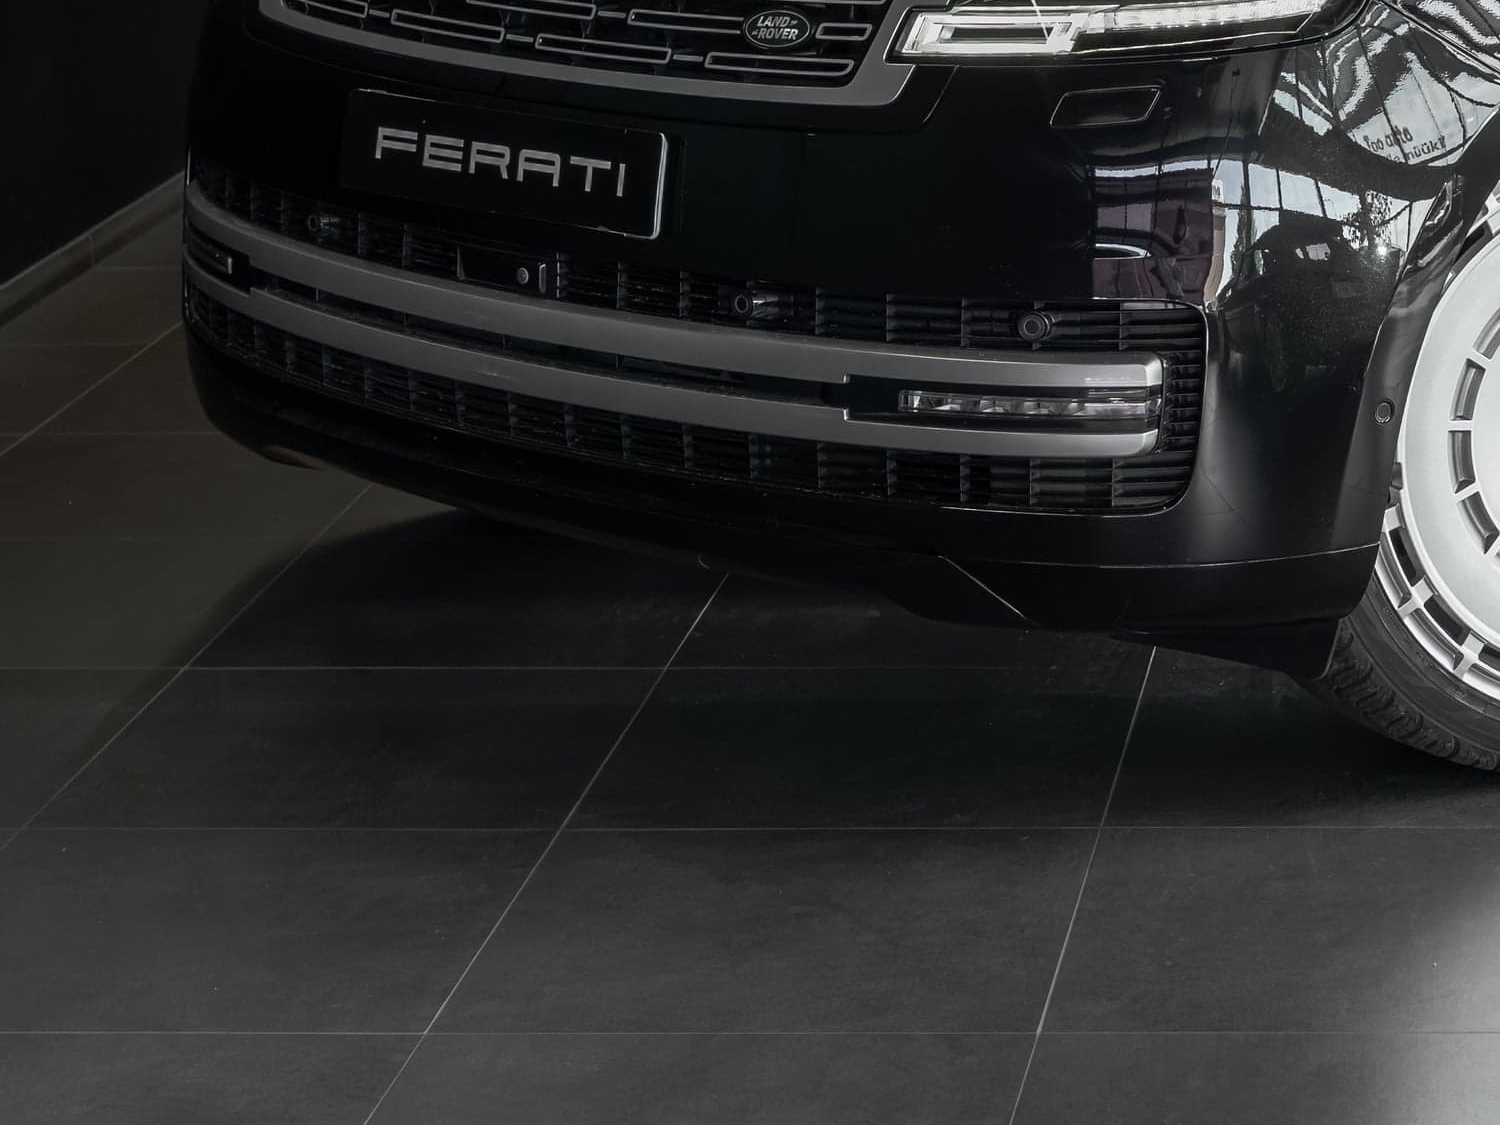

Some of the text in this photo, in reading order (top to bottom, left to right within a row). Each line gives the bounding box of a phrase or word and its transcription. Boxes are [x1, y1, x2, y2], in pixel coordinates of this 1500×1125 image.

[757, 15, 791, 28] LAND
[757, 27, 799, 40] ROVER
[373, 125, 626, 197] FERATI
